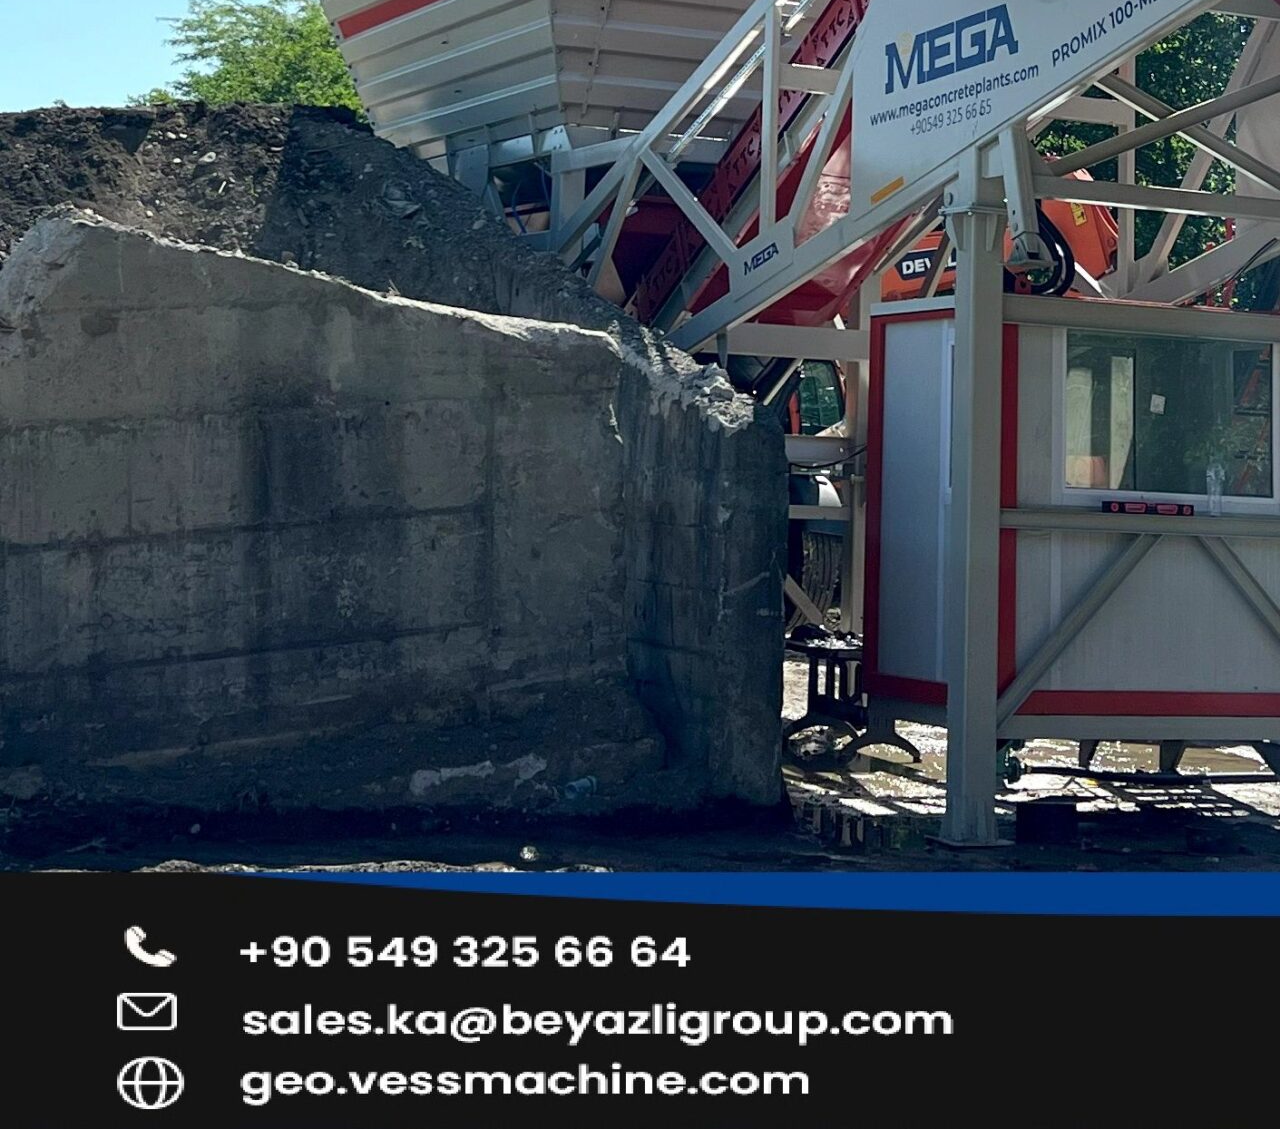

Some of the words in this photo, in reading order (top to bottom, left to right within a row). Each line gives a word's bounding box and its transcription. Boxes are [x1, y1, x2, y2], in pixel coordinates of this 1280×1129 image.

[885, 3, 1019, 95] MEGA
[1052, 16, 1108, 67] PROMIX
[869, 64, 1039, 126] www.megaconcreteplants.com
[946, 107, 963, 127] 325
[965, 102, 978, 120] 66
[744, 242, 779, 275] MEGA
